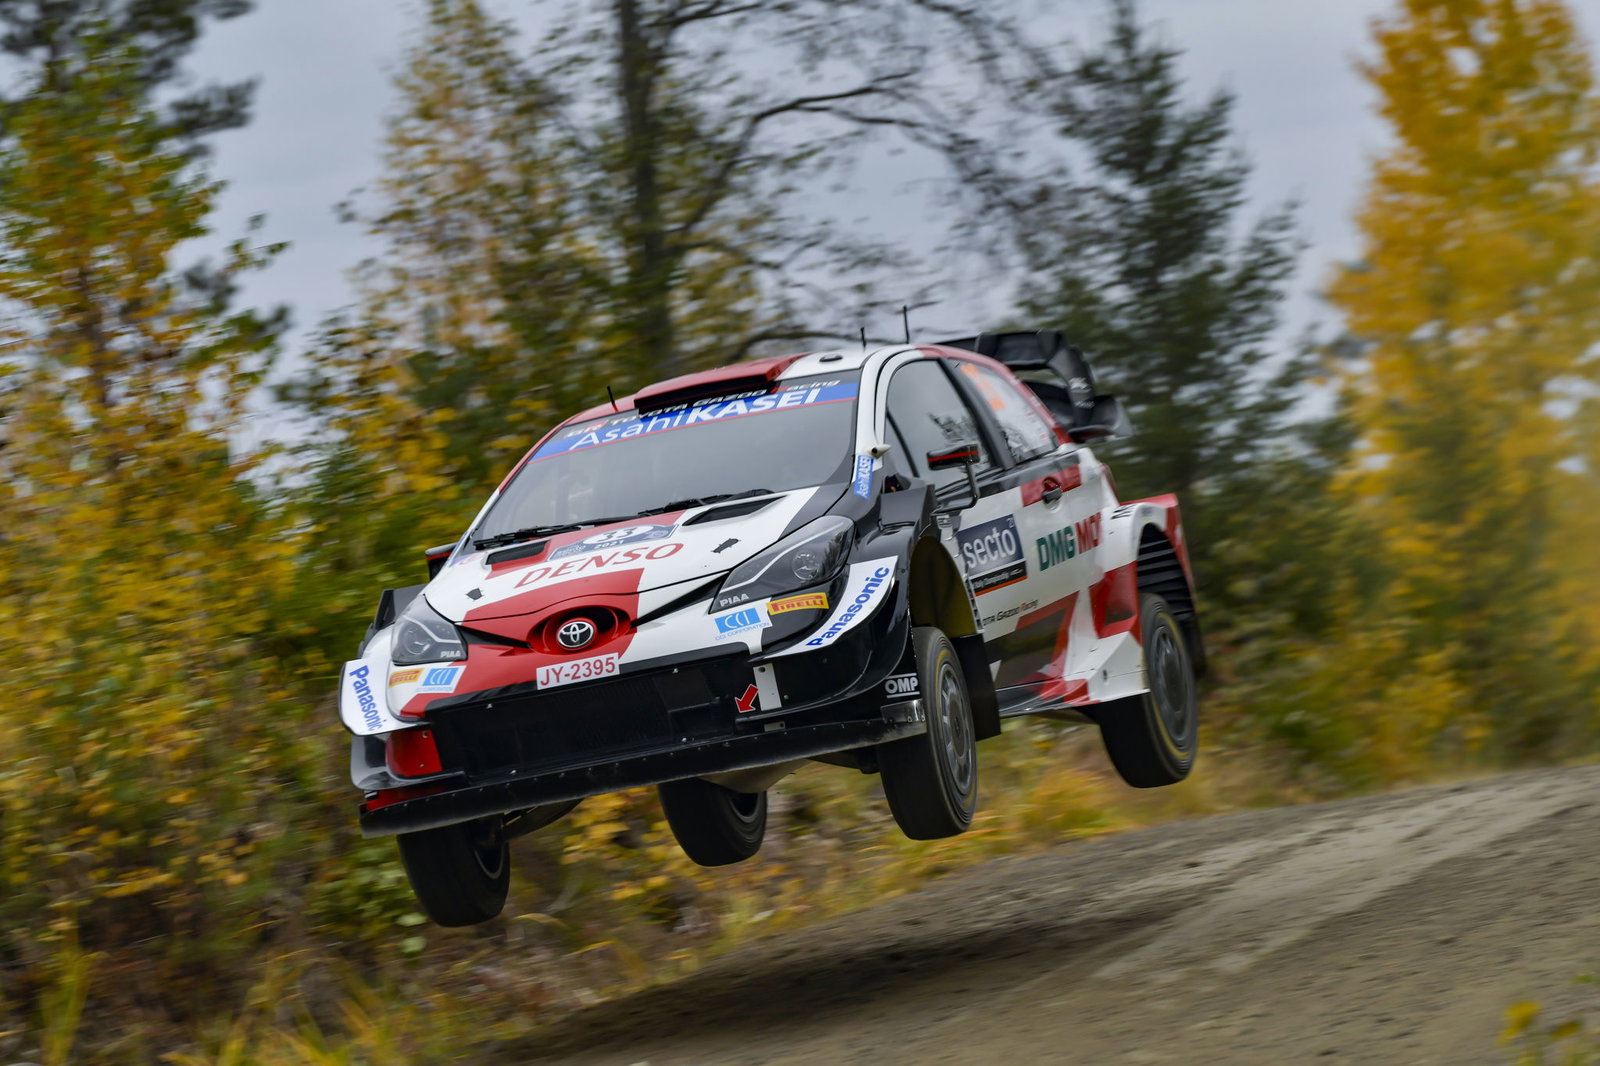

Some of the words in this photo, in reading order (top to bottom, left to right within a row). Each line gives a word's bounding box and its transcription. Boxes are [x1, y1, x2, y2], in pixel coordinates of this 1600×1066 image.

[594, 539, 624, 549] 2021
[963, 527, 1016, 568] secto
[1036, 526, 1075, 571] DMG
[514, 543, 684, 588] DENSO
[720, 593, 749, 607] PIAA
[770, 595, 825, 612] PIRELLI
[806, 567, 890, 646] Panasonic
[440, 650, 461, 658] PIAA
[540, 657, 616, 686] JY-2395
[885, 676, 918, 694] OMP
[349, 665, 384, 731] Panasonic
